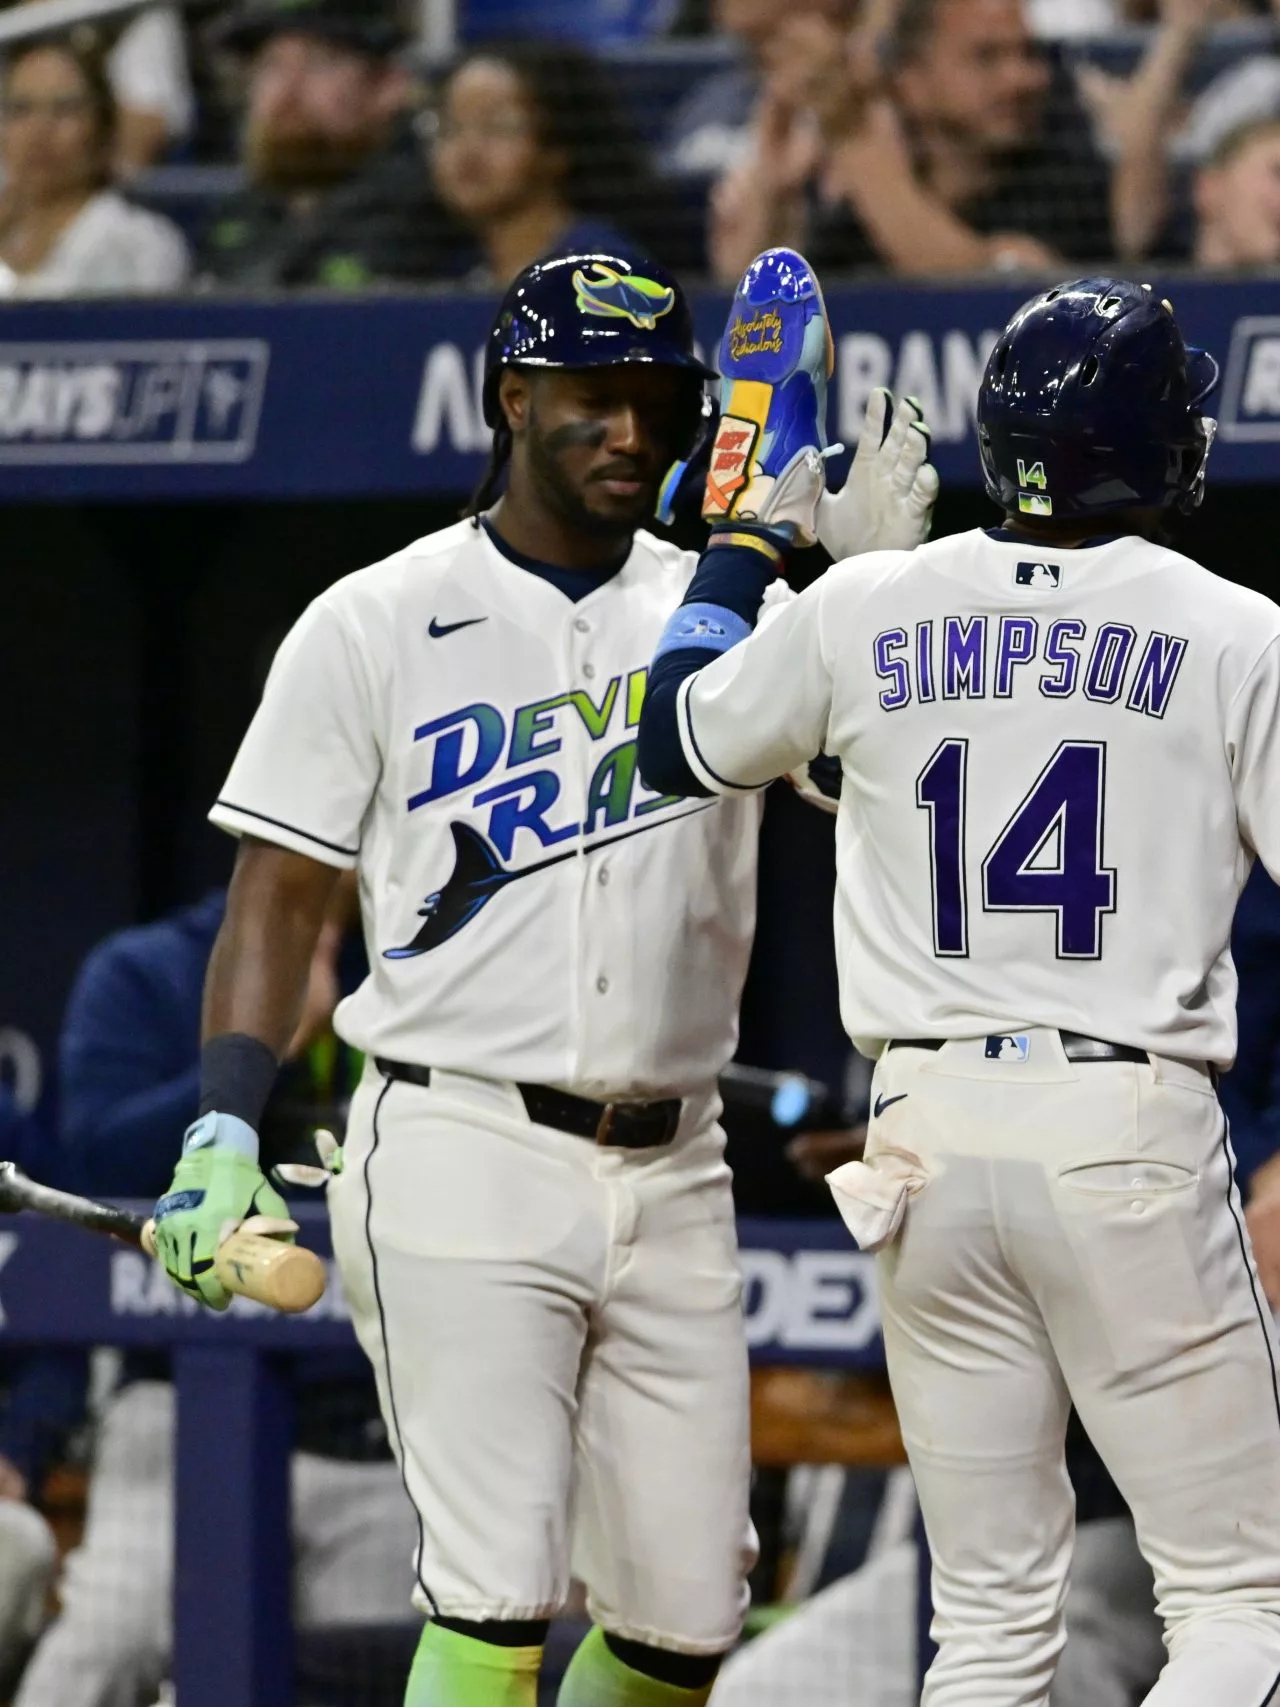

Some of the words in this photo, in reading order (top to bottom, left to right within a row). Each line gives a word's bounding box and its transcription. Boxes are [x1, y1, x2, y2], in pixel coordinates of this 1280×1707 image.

[838, 328, 1000, 444] BAN
[1016, 458, 1048, 490] 14
[873, 615, 1189, 720] SIMPSON
[407, 665, 651, 813] DEVI
[915, 737, 1118, 961] 14
